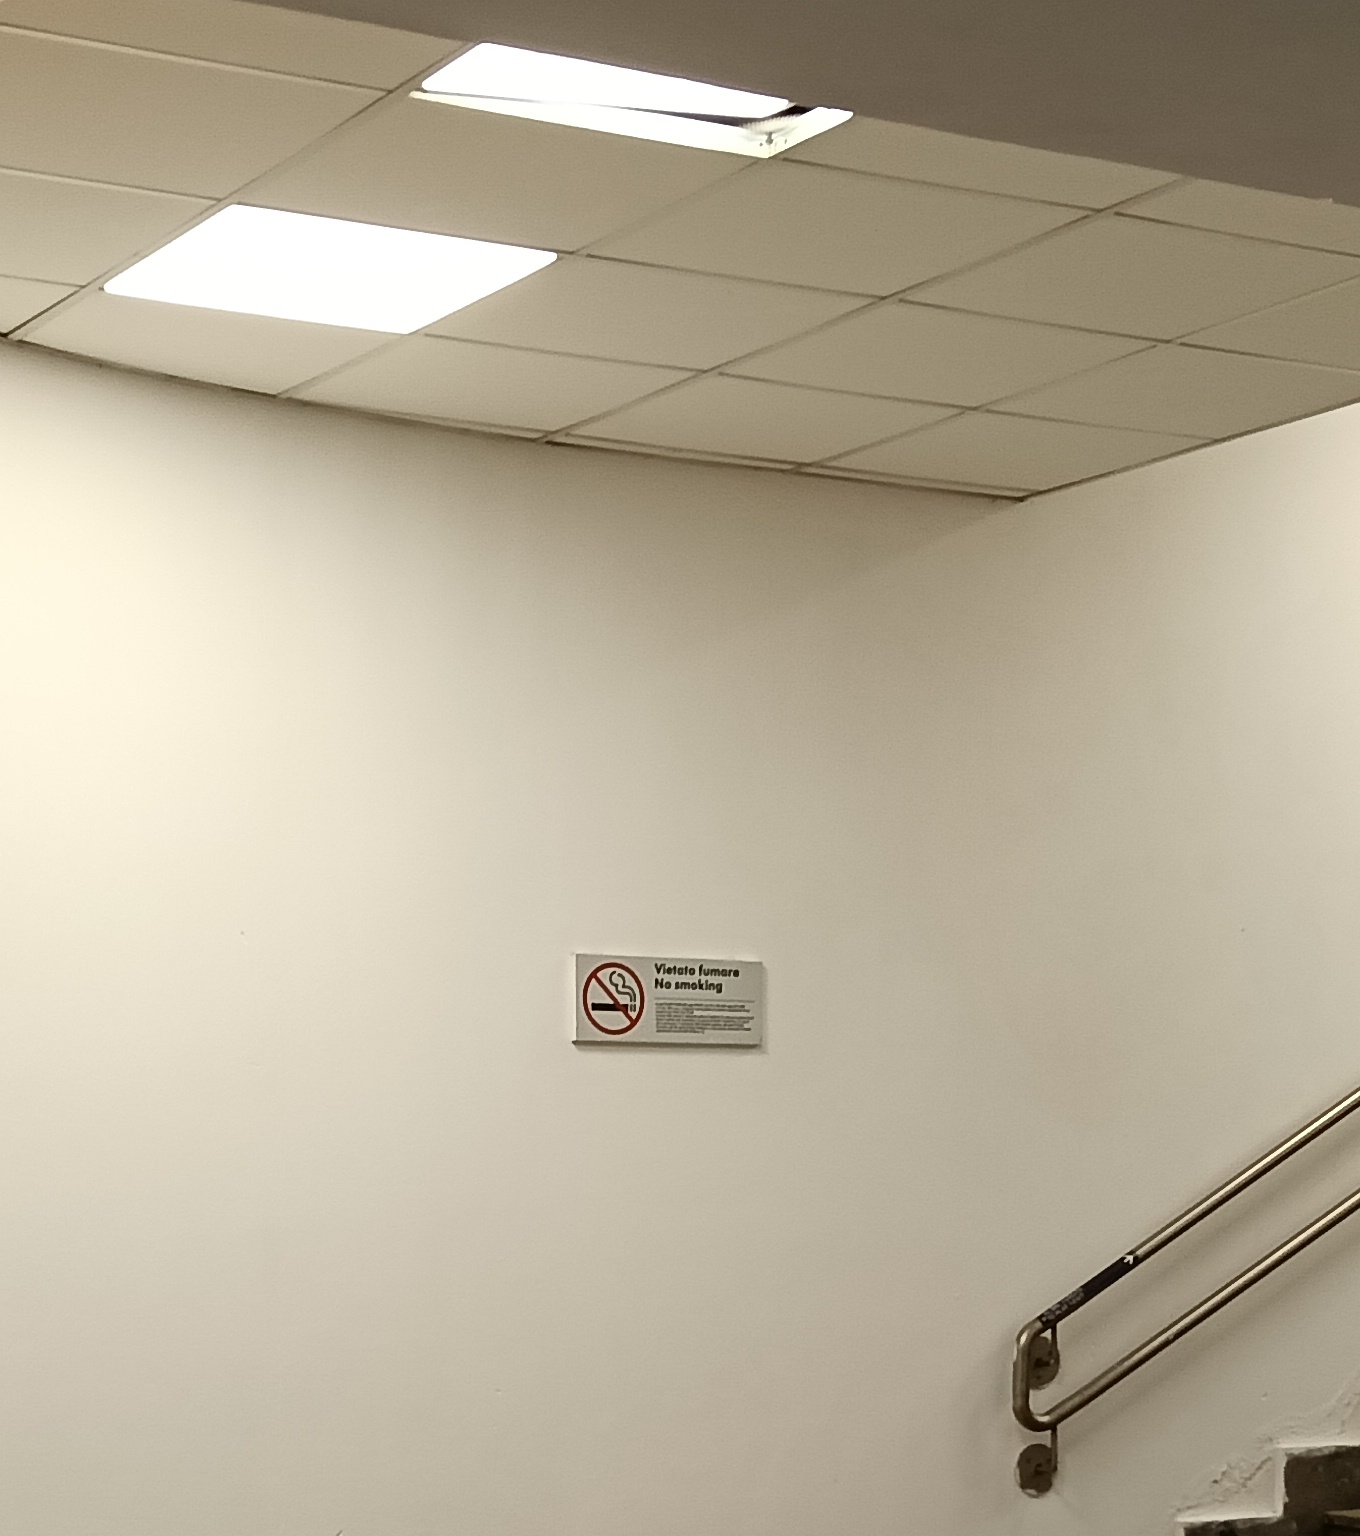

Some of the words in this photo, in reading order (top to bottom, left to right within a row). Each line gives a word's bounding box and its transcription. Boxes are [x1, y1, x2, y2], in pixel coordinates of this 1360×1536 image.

[654, 963, 696, 976] Vietato
[698, 964, 740, 978] fumare
[654, 978, 672, 990] No
[674, 979, 723, 994] smoking
